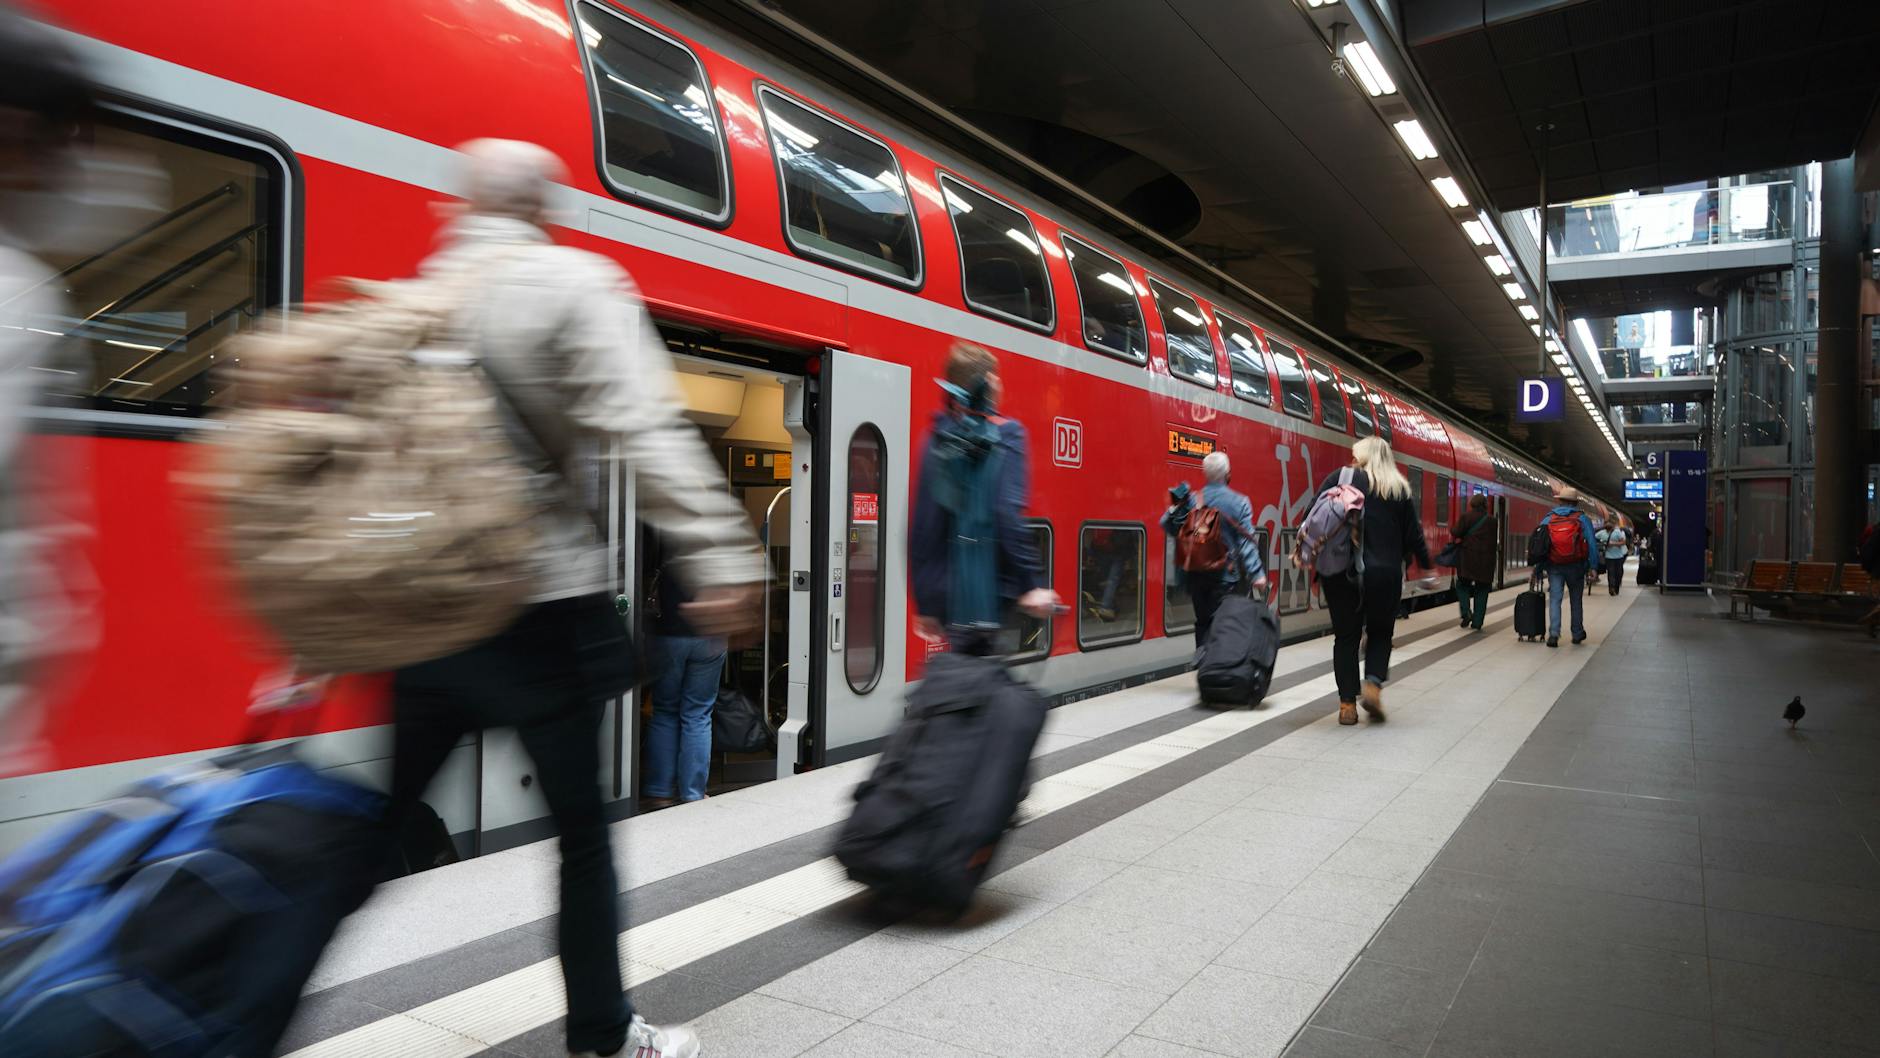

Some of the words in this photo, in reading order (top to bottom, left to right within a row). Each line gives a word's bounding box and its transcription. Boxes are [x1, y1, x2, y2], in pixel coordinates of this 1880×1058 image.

[1523, 380, 1549, 412] D
[1056, 424, 1080, 460] DB
[1647, 452, 1657, 465] 6
[1648, 511, 1656, 520] C
